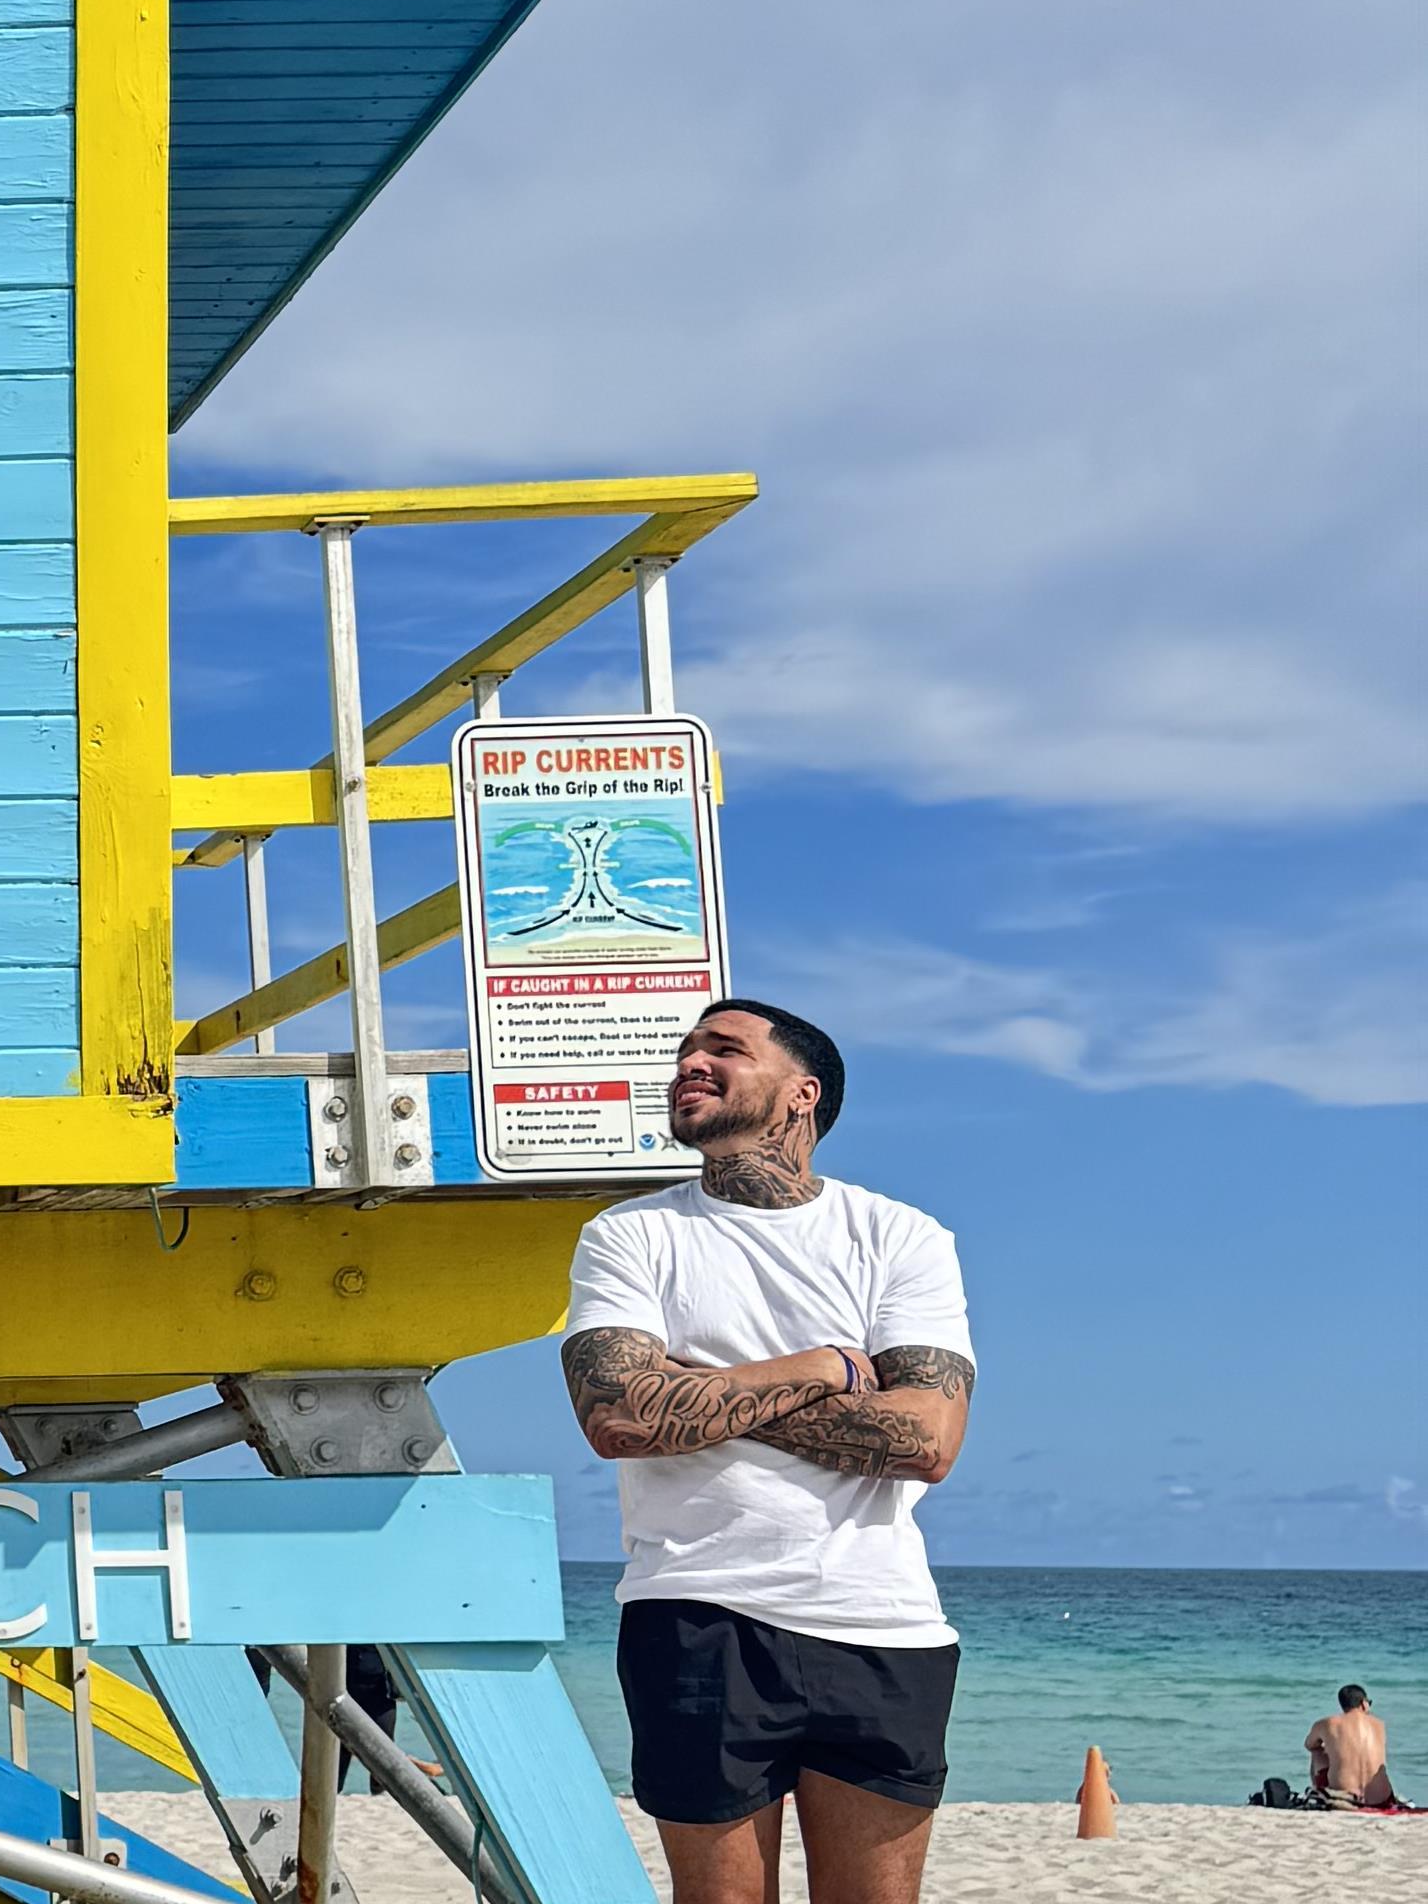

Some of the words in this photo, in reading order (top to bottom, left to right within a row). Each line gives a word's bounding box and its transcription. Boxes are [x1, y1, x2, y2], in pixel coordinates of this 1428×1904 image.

[482, 750, 526, 775] RIP
[536, 745, 685, 773] CURRENTS
[484, 782, 530, 797] Break
[535, 781, 560, 796] the
[566, 780, 597, 797] Grip
[603, 779, 618, 794] of
[623, 779, 648, 793] the
[654, 778, 684, 794] Rip!
[493, 979, 507, 993] IF
[510, 978, 570, 993] CAUGHT
[574, 977, 590, 992] IN
[593, 977, 604, 991] A
[607, 976, 631, 990] RIP
[634, 975, 704, 989] CURRENT
[524, 1086, 600, 1100] SAFETY
